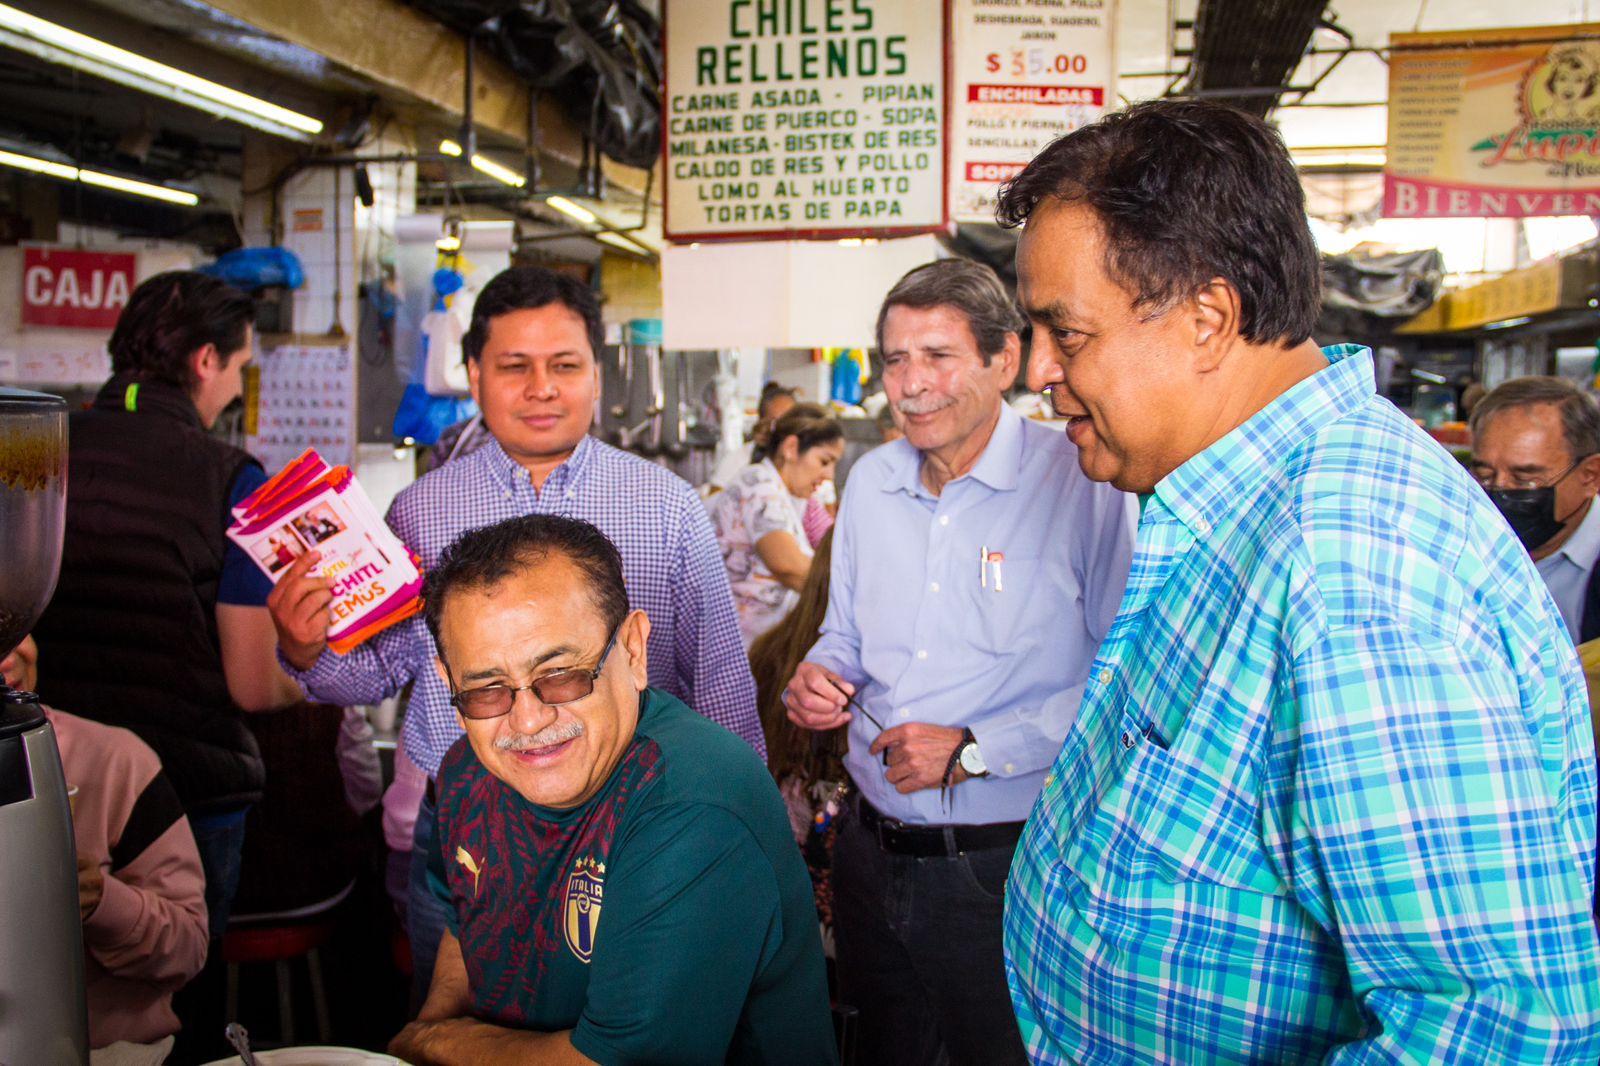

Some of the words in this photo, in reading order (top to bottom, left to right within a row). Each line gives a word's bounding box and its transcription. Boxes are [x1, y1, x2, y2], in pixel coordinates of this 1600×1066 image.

[730, 0, 873, 38] CHILES
[696, 36, 906, 86] RELLENOS
[672, 93, 739, 114] CARNE
[751, 89, 821, 109] ASADA
[863, 84, 934, 102] PIPIAN
[978, 87, 1093, 104] ENCHILADAS
[670, 115, 733, 136] CARNE
[743, 113, 766, 131] DE
[775, 109, 857, 129] PUERCO
[882, 107, 937, 126] SOPA
[669, 136, 770, 157] MILANESA
[784, 133, 854, 152] BISTEK
[864, 131, 888, 149] DE
[898, 130, 937, 147] RES
[674, 160, 741, 180] CALDO
[751, 159, 774, 176] DE
[784, 156, 824, 174] RES
[835, 155, 847, 172] Y
[858, 153, 928, 171] POLLO
[698, 182, 759, 201] LOMO
[774, 180, 800, 198] AL
[813, 177, 909, 196] HUERTO
[1393, 182, 1600, 217] BIENVEN
[705, 203, 791, 223] TORTAS
[804, 202, 830, 219] DE
[844, 201, 902, 217] PAPA
[26, 265, 130, 310] CAJA
[330, 562, 383, 597] CHITL
[571, 879, 603, 898] ITALIA
